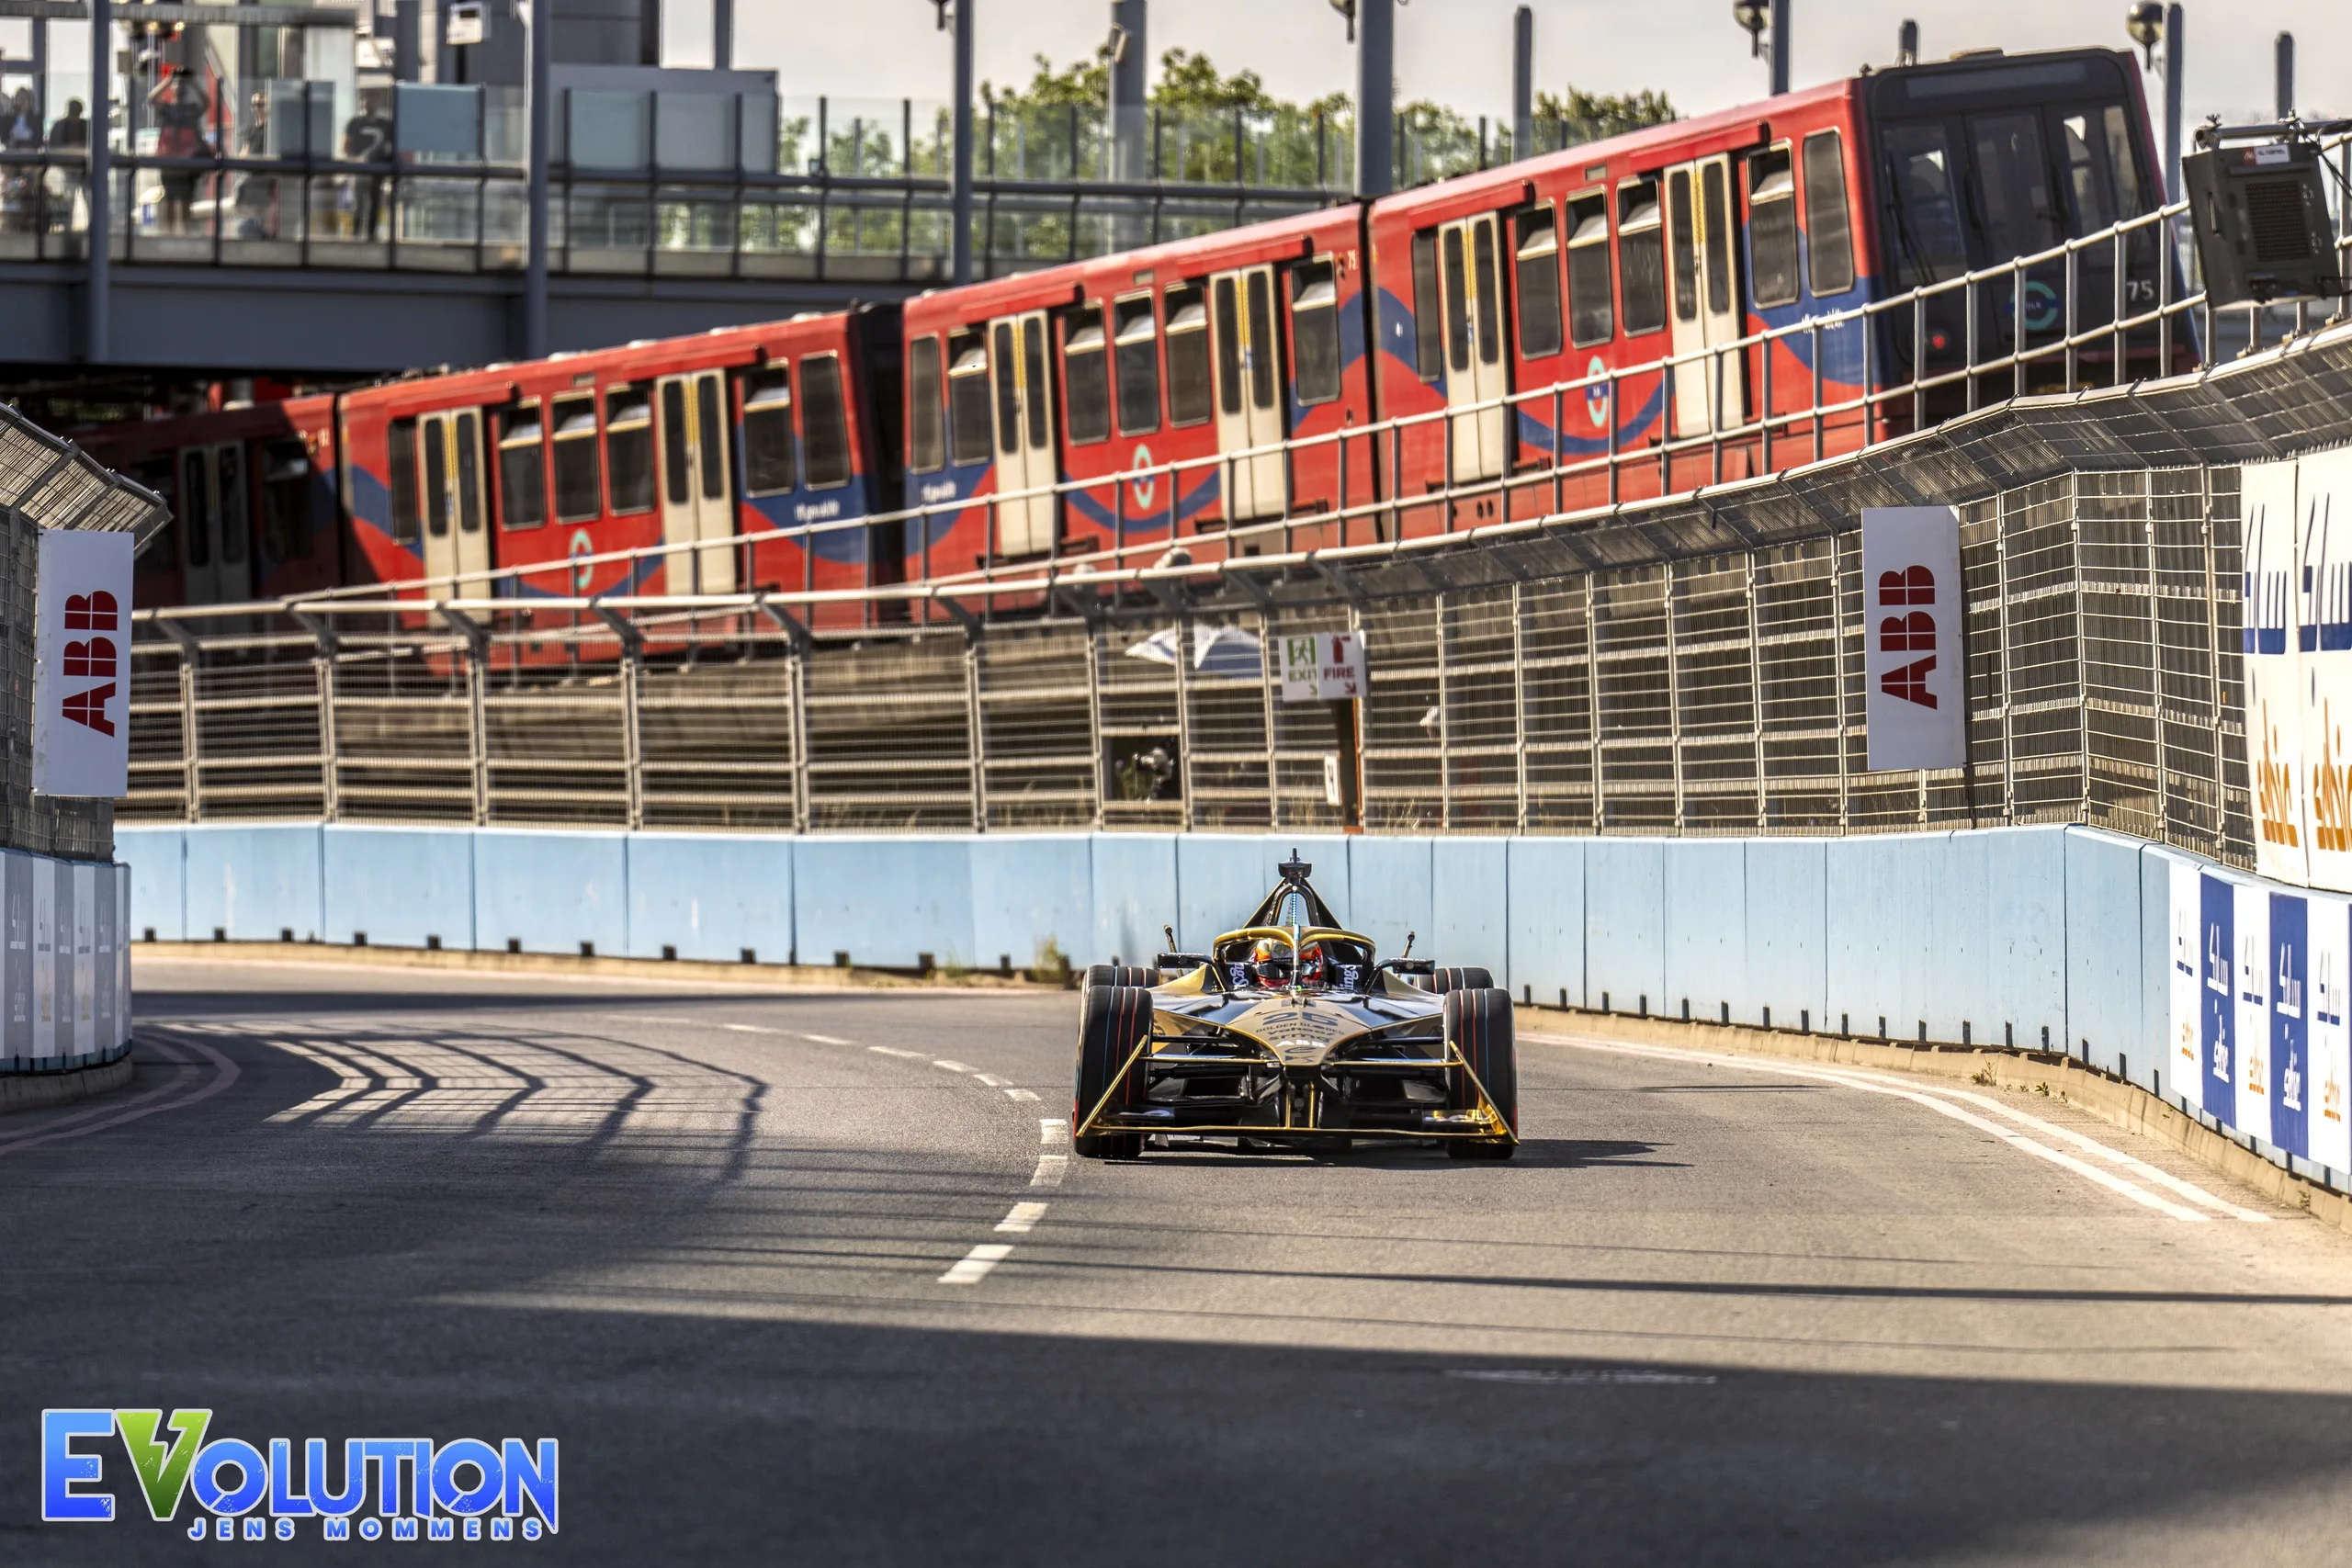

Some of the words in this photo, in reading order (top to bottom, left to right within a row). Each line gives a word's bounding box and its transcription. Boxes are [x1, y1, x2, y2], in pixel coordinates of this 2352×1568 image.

[2126, 278, 2155, 302] 75
[1879, 564, 1938, 711] ABB
[62, 590, 119, 738] ABB
[1323, 666, 1355, 681] FIRE
[1262, 1011, 1339, 1027] 25
